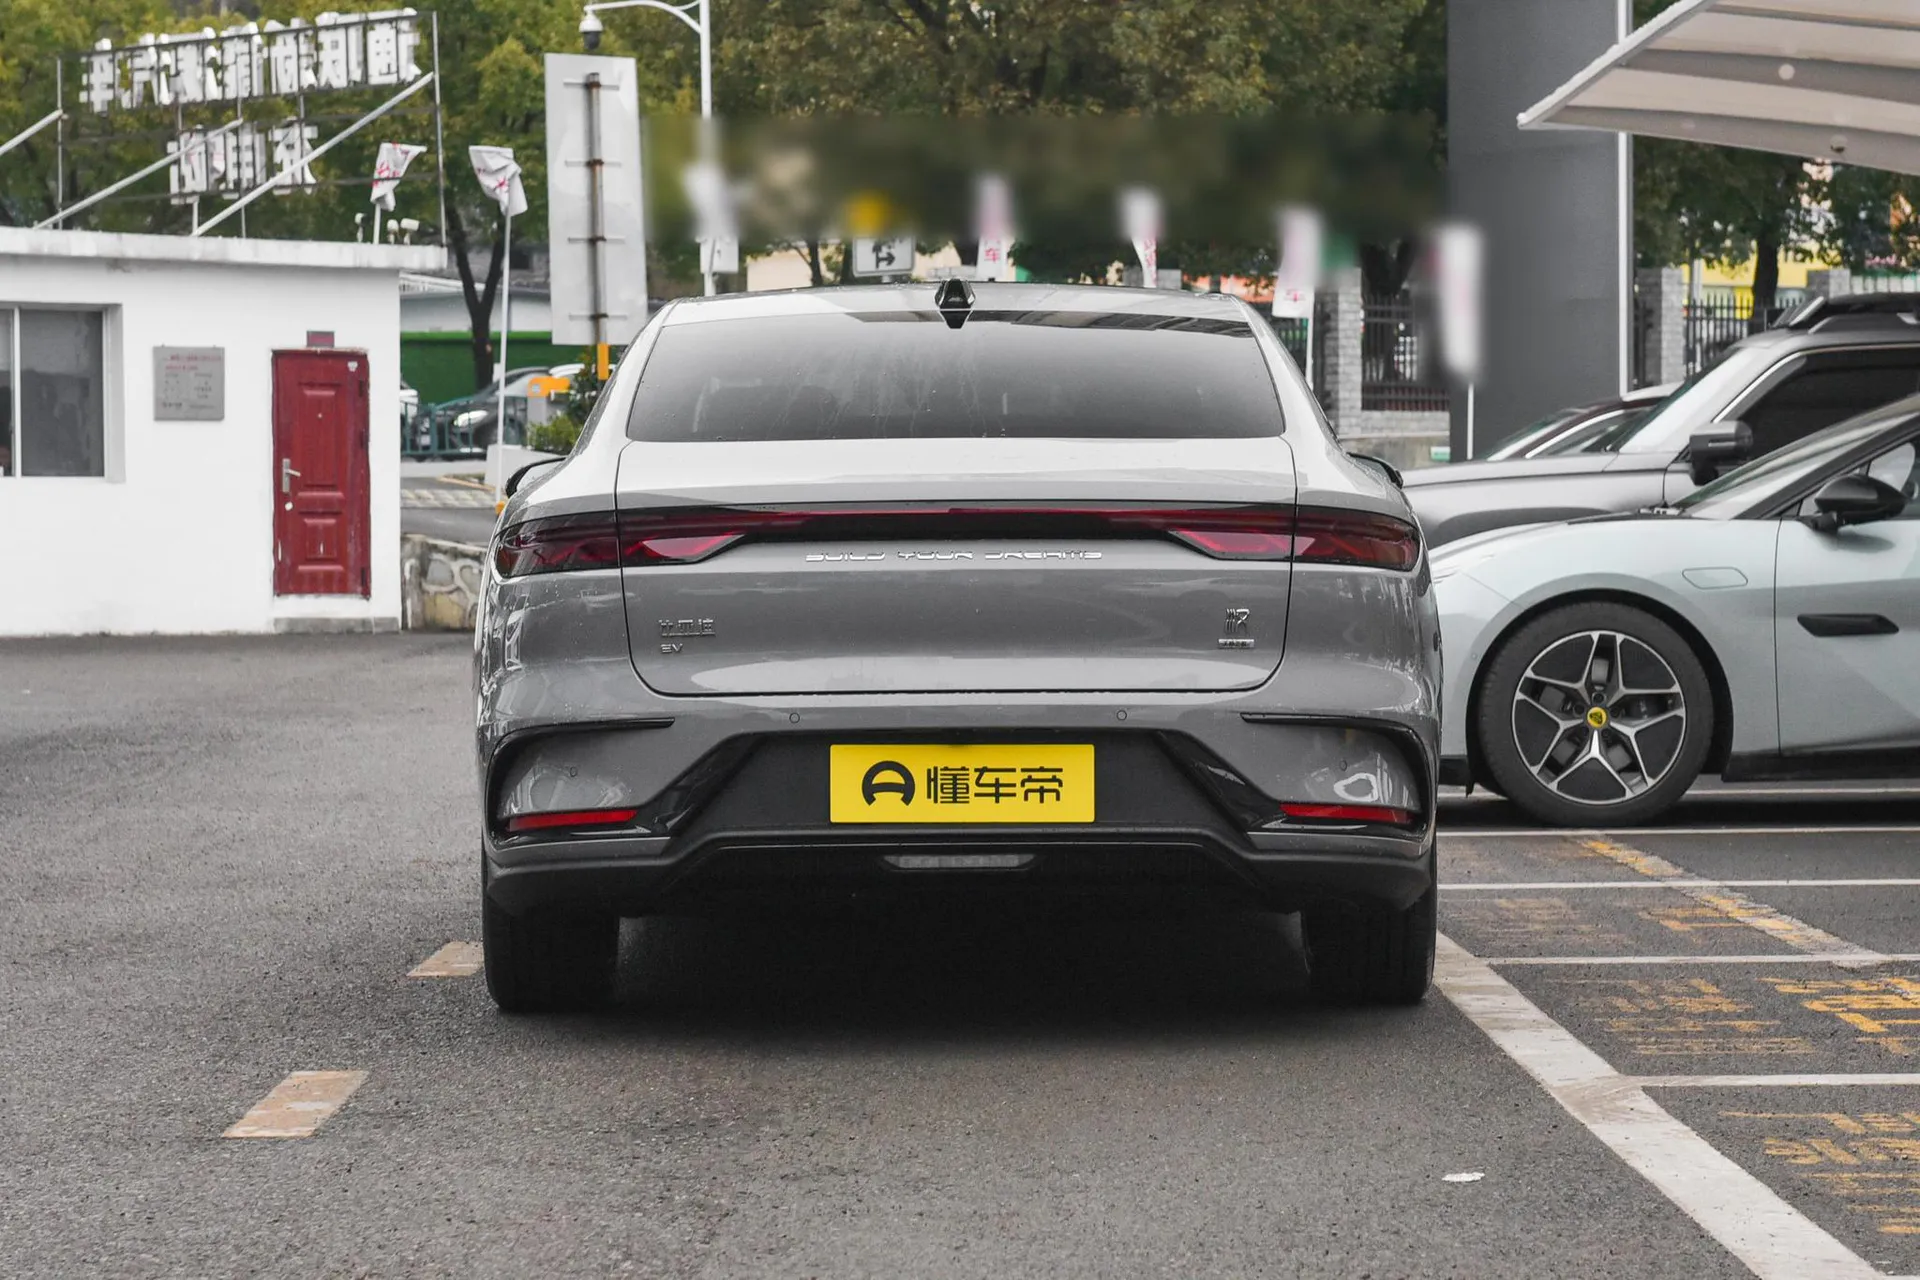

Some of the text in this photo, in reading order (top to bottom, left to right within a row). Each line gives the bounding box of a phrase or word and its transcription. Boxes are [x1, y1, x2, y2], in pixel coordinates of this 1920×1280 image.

[805, 550, 1103, 562] BUILD YOUR DREAMS
[658, 618, 716, 637] 比亚迪
[661, 643, 683, 653] EV
[926, 765, 1064, 804] 懂车帝
